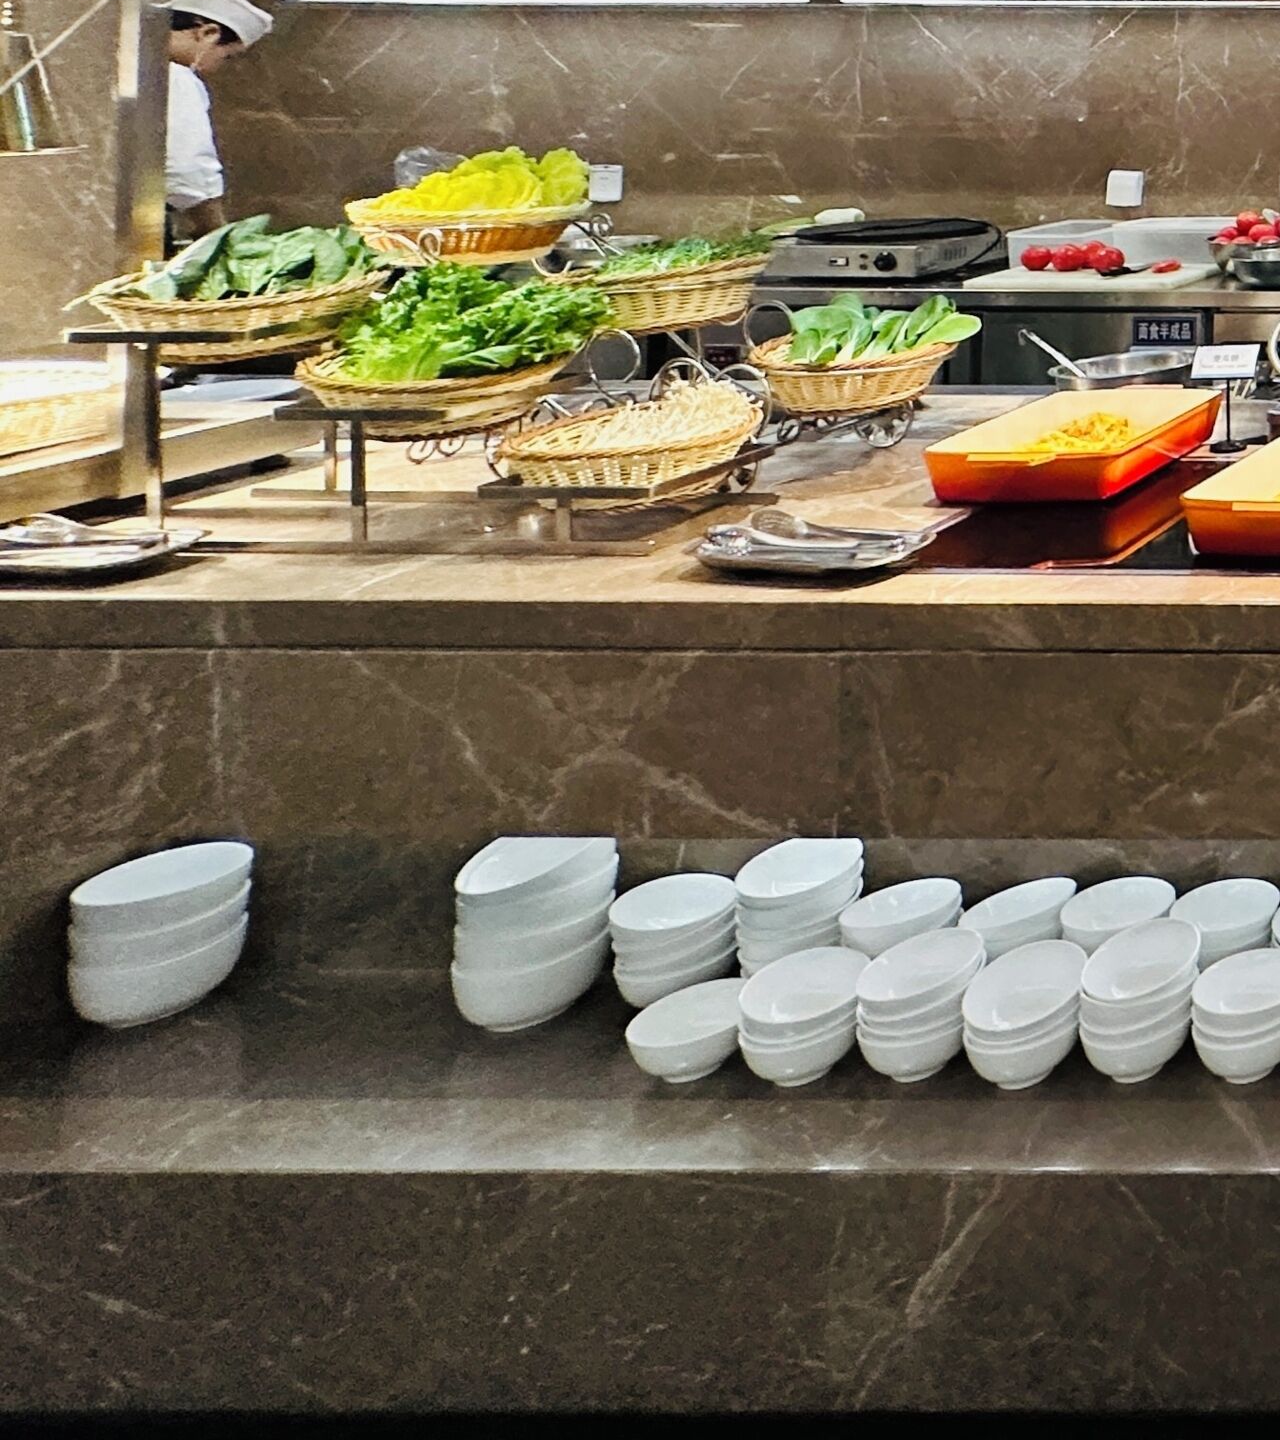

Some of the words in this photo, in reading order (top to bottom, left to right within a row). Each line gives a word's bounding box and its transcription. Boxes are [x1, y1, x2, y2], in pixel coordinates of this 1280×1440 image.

[1138, 322, 1191, 340] 面食半成品
